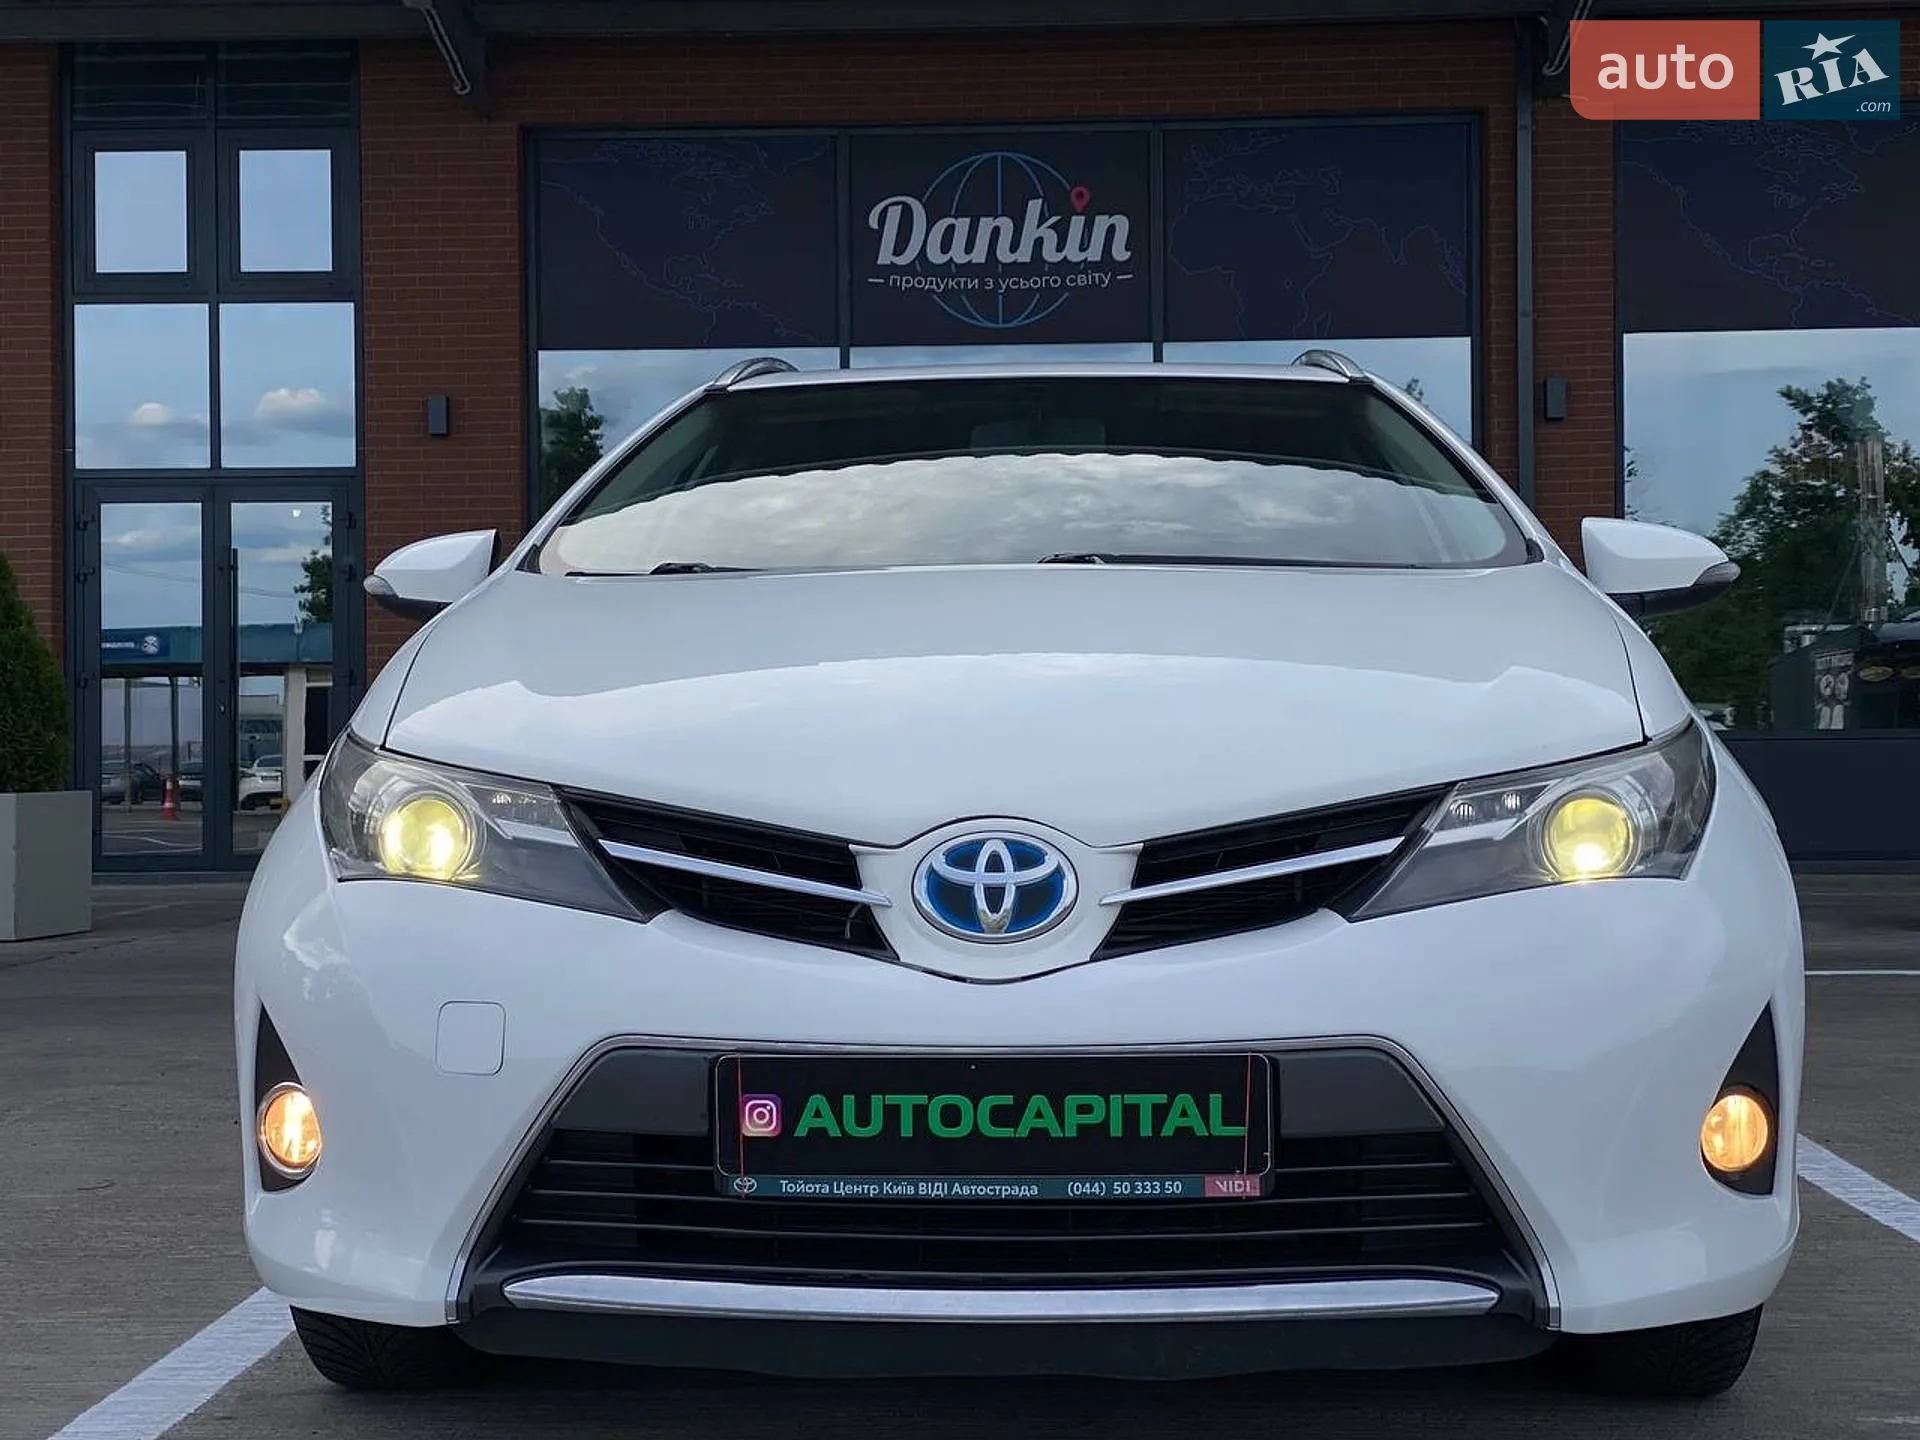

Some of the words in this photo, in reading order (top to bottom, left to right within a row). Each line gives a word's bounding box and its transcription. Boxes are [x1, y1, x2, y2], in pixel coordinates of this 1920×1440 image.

[868, 195, 1132, 265] Dankin
[889, 275, 979, 293] продукти
[984, 275, 994, 290] з
[999, 275, 1061, 293] усього
[1066, 270, 1112, 288] світу
[793, 1093, 1248, 1138] AUTOCAPITAL
[780, 1179, 830, 1195] Тойота
[833, 1181, 879, 1198] Центр
[883, 1181, 915, 1195] Київ
[918, 1182, 948, 1198] ВІДІ
[952, 1181, 1038, 1198] Автострада
[1067, 1181, 1107, 1197] (044)
